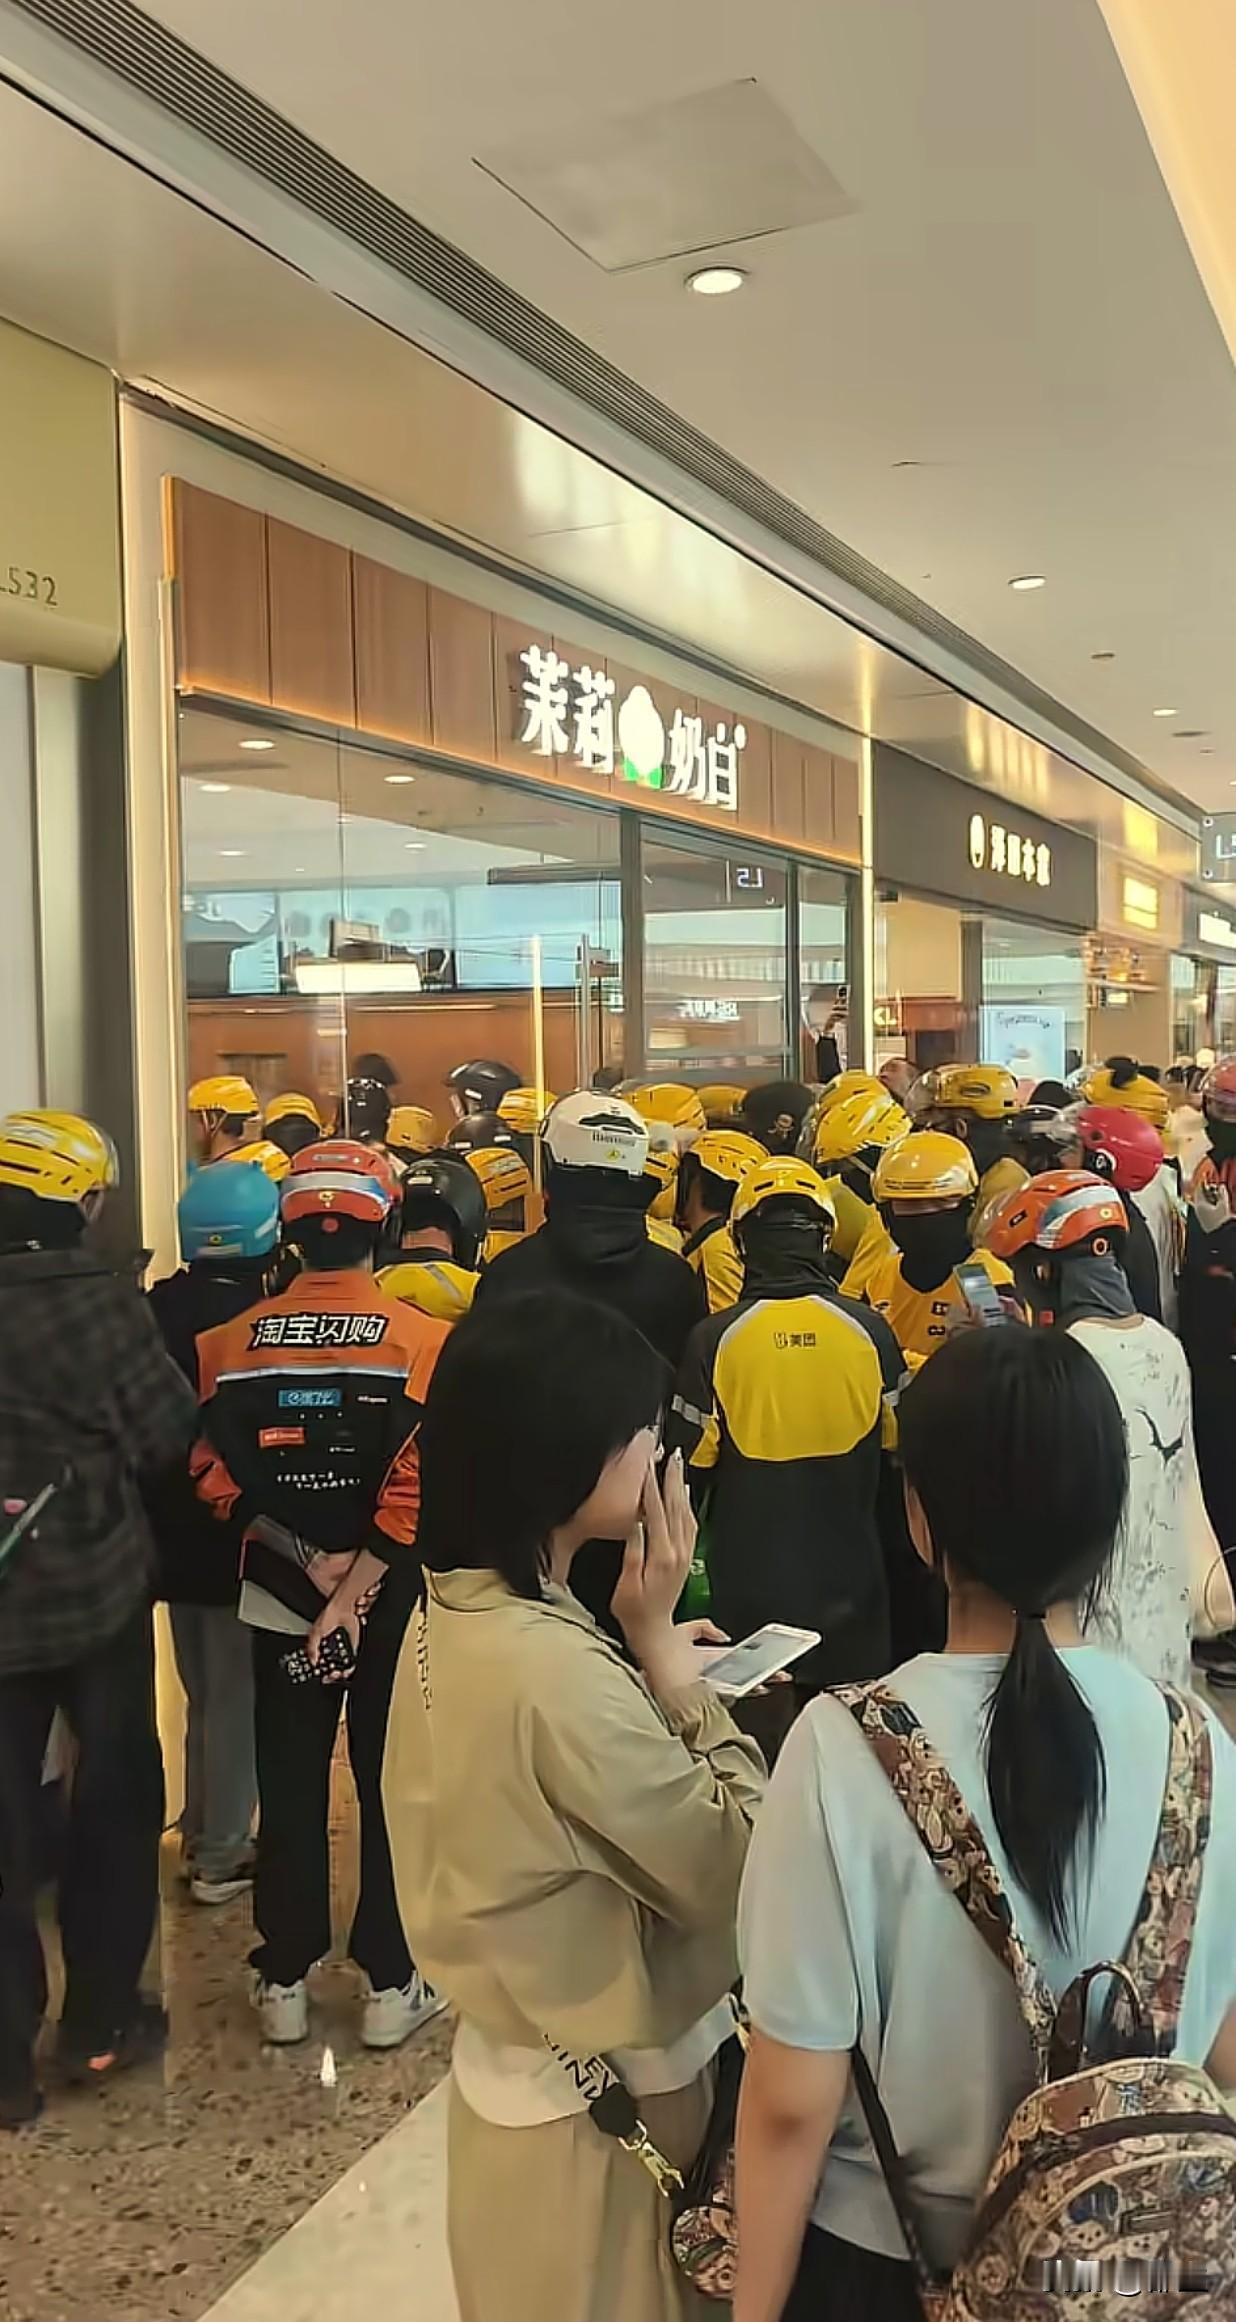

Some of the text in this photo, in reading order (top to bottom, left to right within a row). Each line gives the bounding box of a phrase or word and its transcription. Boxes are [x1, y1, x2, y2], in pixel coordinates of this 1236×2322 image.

[520, 644, 738, 811] 茉莉 奶白
[254, 1315, 386, 1347] 淘宝闪购
